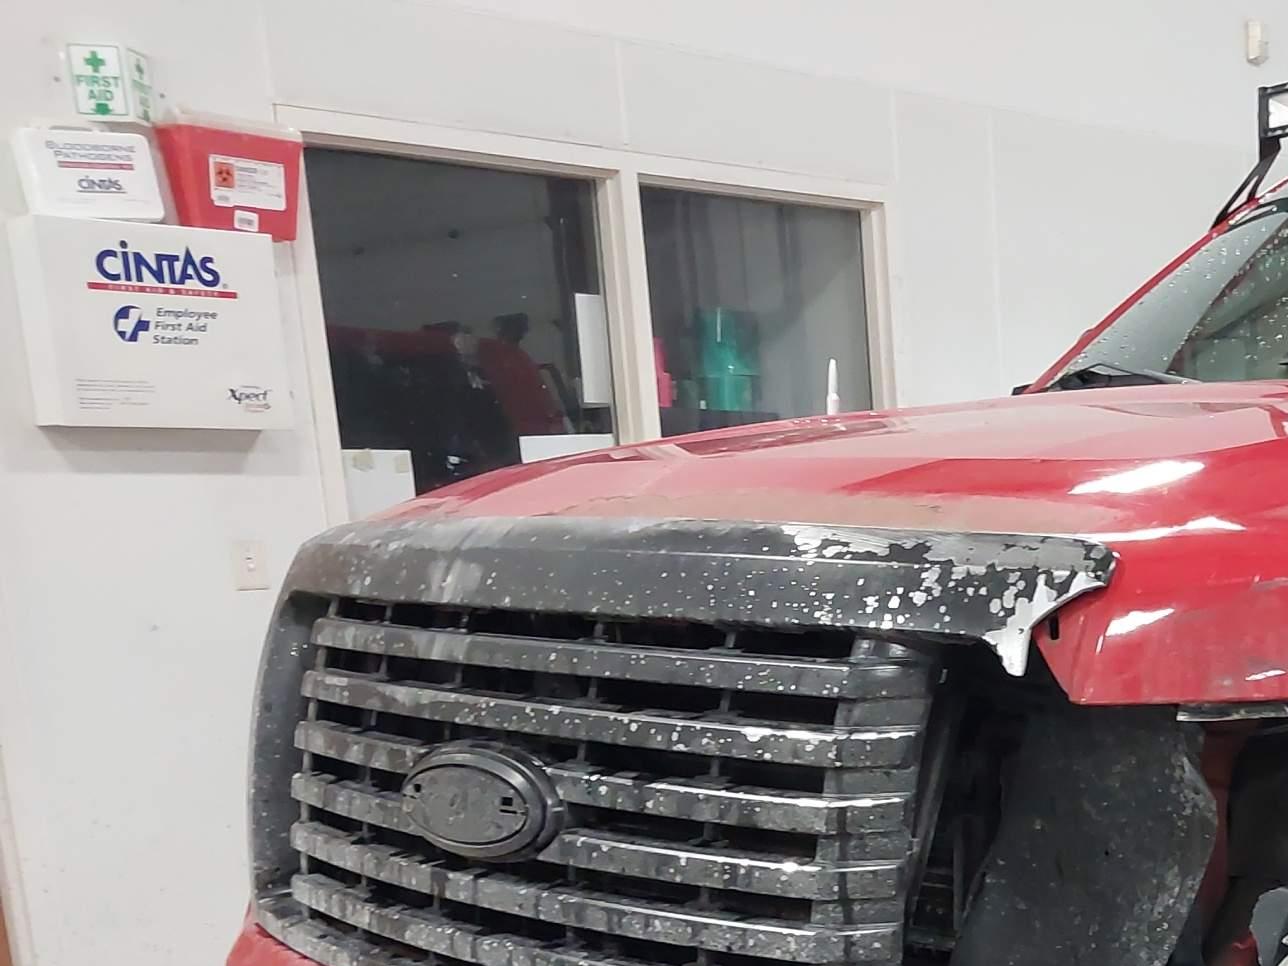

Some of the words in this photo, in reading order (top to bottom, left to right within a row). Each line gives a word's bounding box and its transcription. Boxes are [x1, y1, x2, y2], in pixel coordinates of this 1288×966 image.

[76, 75, 119, 88] FIRST
[88, 89, 114, 101] AID
[45, 140, 136, 153] BLOODBORNE
[54, 150, 134, 161] PATHOGENS
[156, 308, 219, 321] Employee
[154, 320, 181, 332] First
[186, 322, 207, 333] Aid
[153, 334, 199, 346] Station
